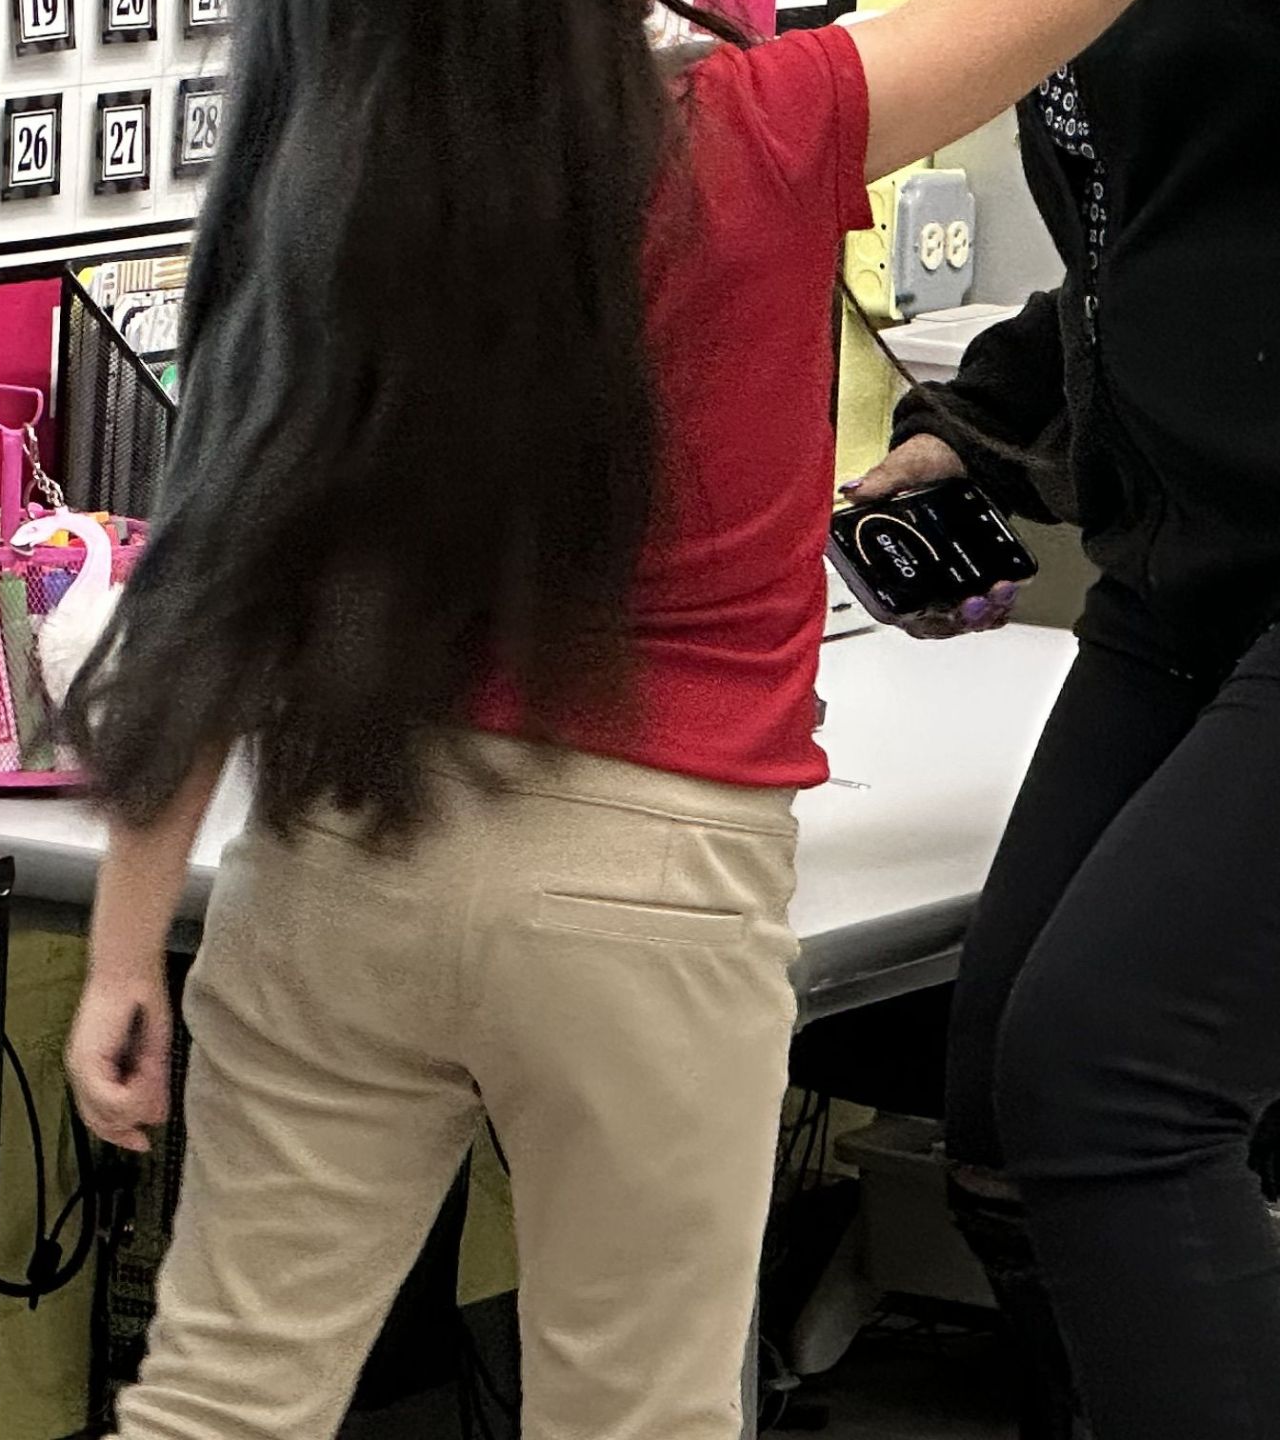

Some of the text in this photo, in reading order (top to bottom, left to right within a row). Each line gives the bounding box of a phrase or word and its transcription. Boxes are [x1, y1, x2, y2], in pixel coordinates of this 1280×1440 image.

[17, 104, 219, 172] 26 27 28
